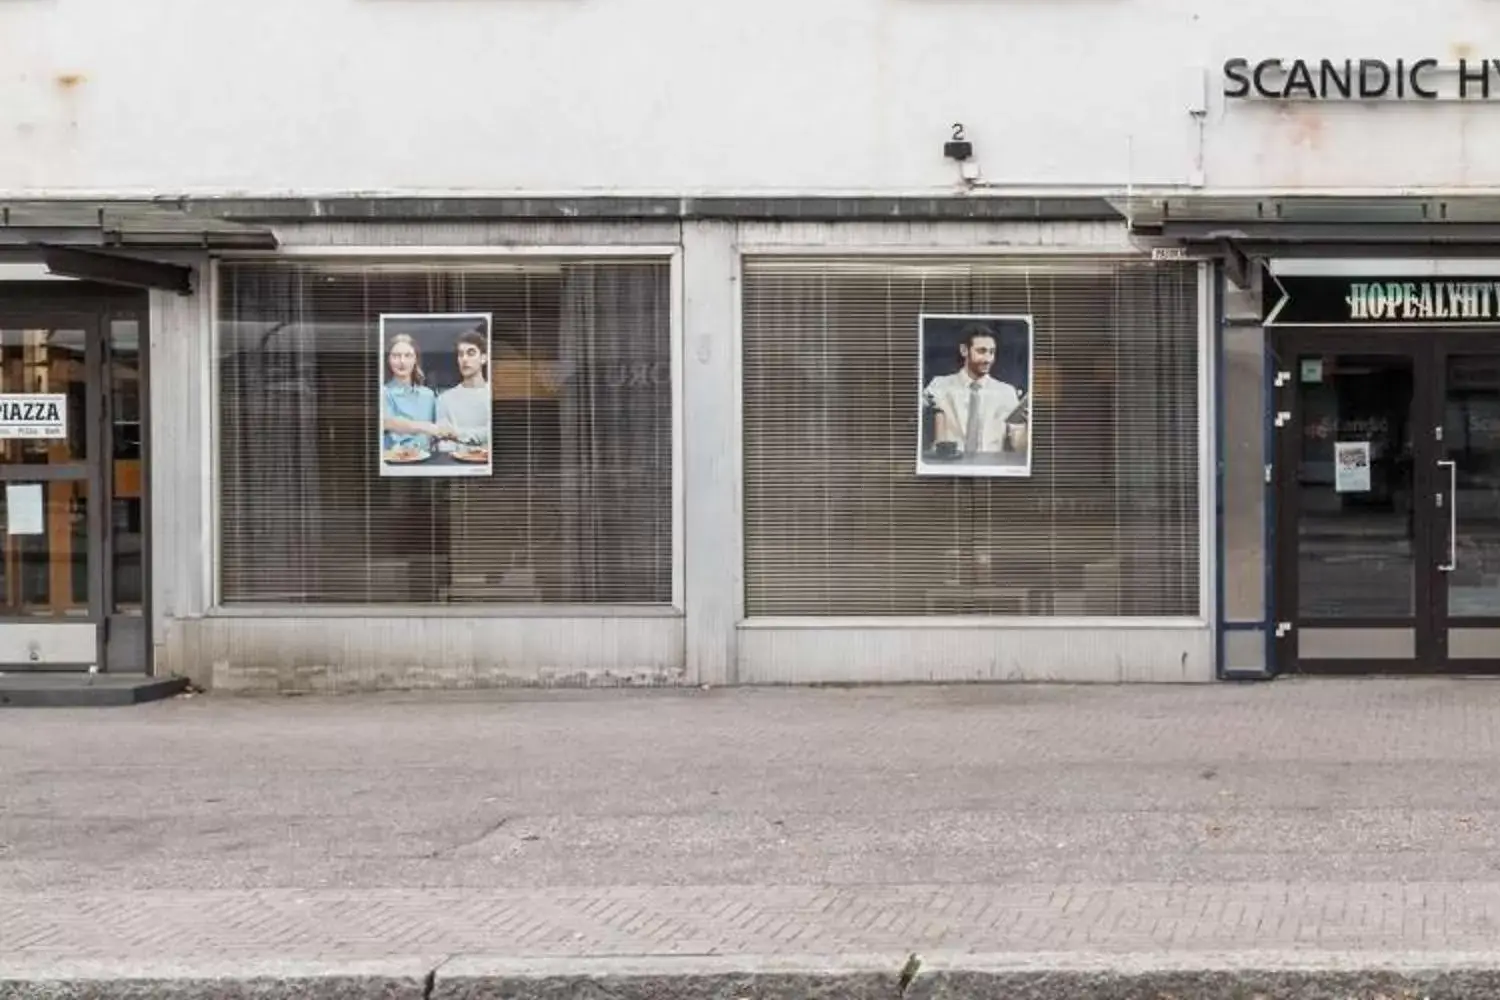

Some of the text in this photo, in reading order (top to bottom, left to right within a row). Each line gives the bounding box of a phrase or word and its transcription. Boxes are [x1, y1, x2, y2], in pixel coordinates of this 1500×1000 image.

[1222, 57, 1439, 99] SCANDIC
[951, 122, 964, 140] 2
[0, 402, 60, 420] IAZZA
